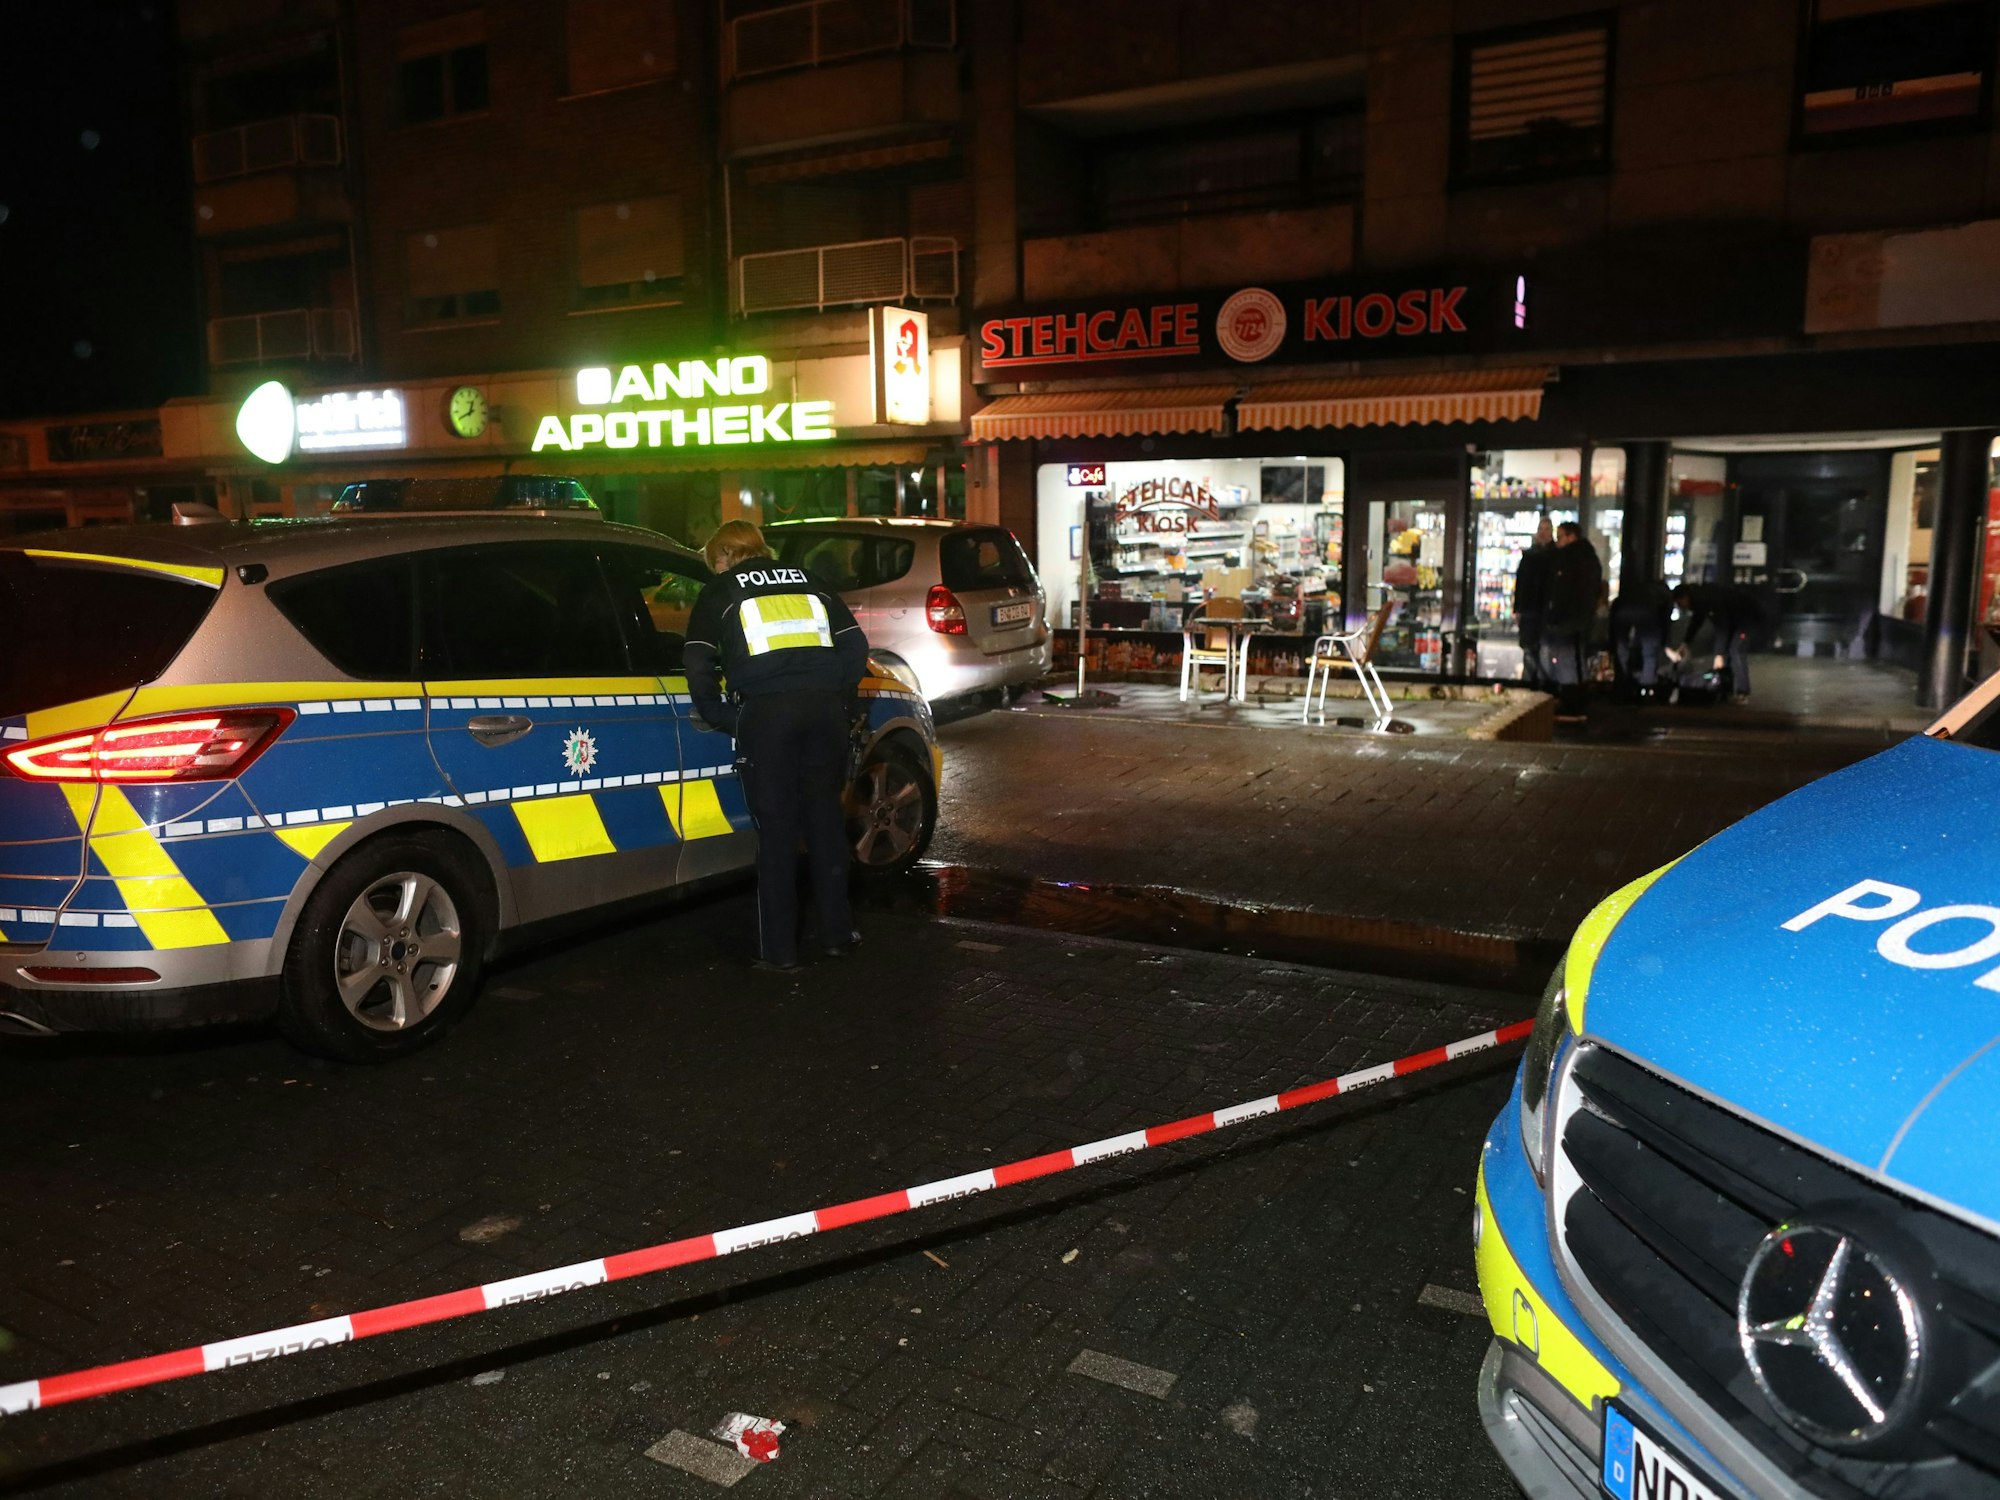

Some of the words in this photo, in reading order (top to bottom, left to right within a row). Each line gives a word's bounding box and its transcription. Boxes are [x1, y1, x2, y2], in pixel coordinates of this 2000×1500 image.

[981, 304, 1200, 360] STEHCAFE
[1236, 322, 1265, 337] 7/24
[1304, 287, 1467, 342] KIOSK
[611, 355, 768, 403] ANNO
[531, 400, 835, 451] APOTHEKE
[1116, 477, 1219, 514] STEHCAFE
[1137, 515, 1199, 533] KIOSK
[735, 568, 808, 588] POLIZEI
[1780, 878, 2000, 993] PO
[1613, 1461, 1624, 1483] D
